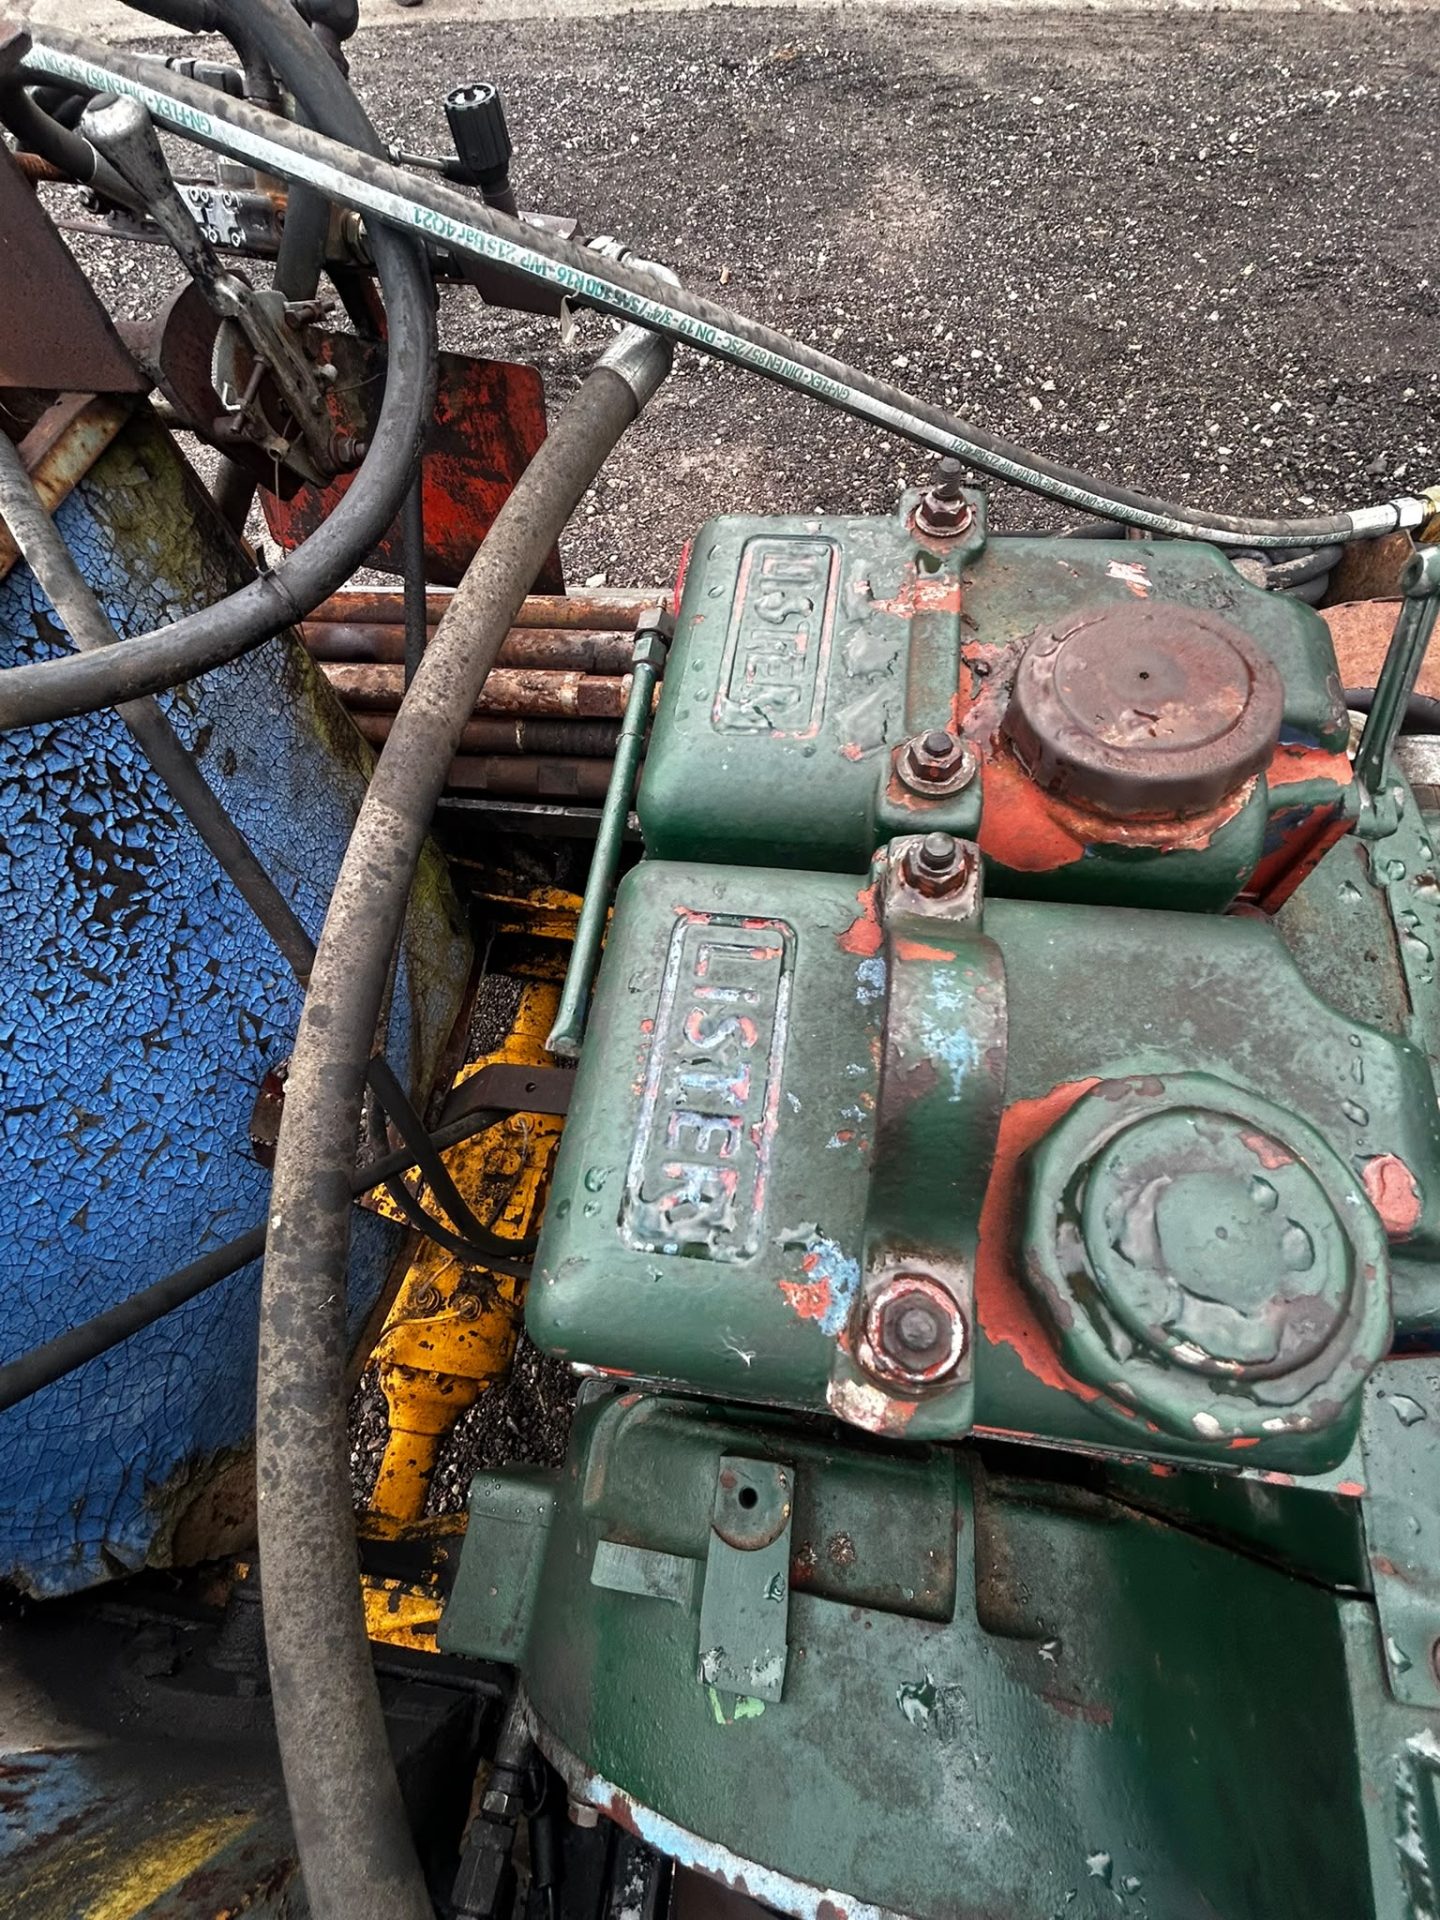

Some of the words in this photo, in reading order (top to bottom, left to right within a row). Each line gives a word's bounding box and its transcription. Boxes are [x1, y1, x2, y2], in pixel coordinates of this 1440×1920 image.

[155, 96, 212, 136] GN-FLEX
[413, 207, 457, 239] 4Q21
[457, 227, 486, 252] Bar
[678, 318, 694, 335] 19
[694, 324, 717, 345] DN
[766, 354, 784, 372] EN
[783, 362, 805, 382] DIN
[808, 374, 851, 401] GN-FLEX
[661, 943, 781, 1231] LISTER
